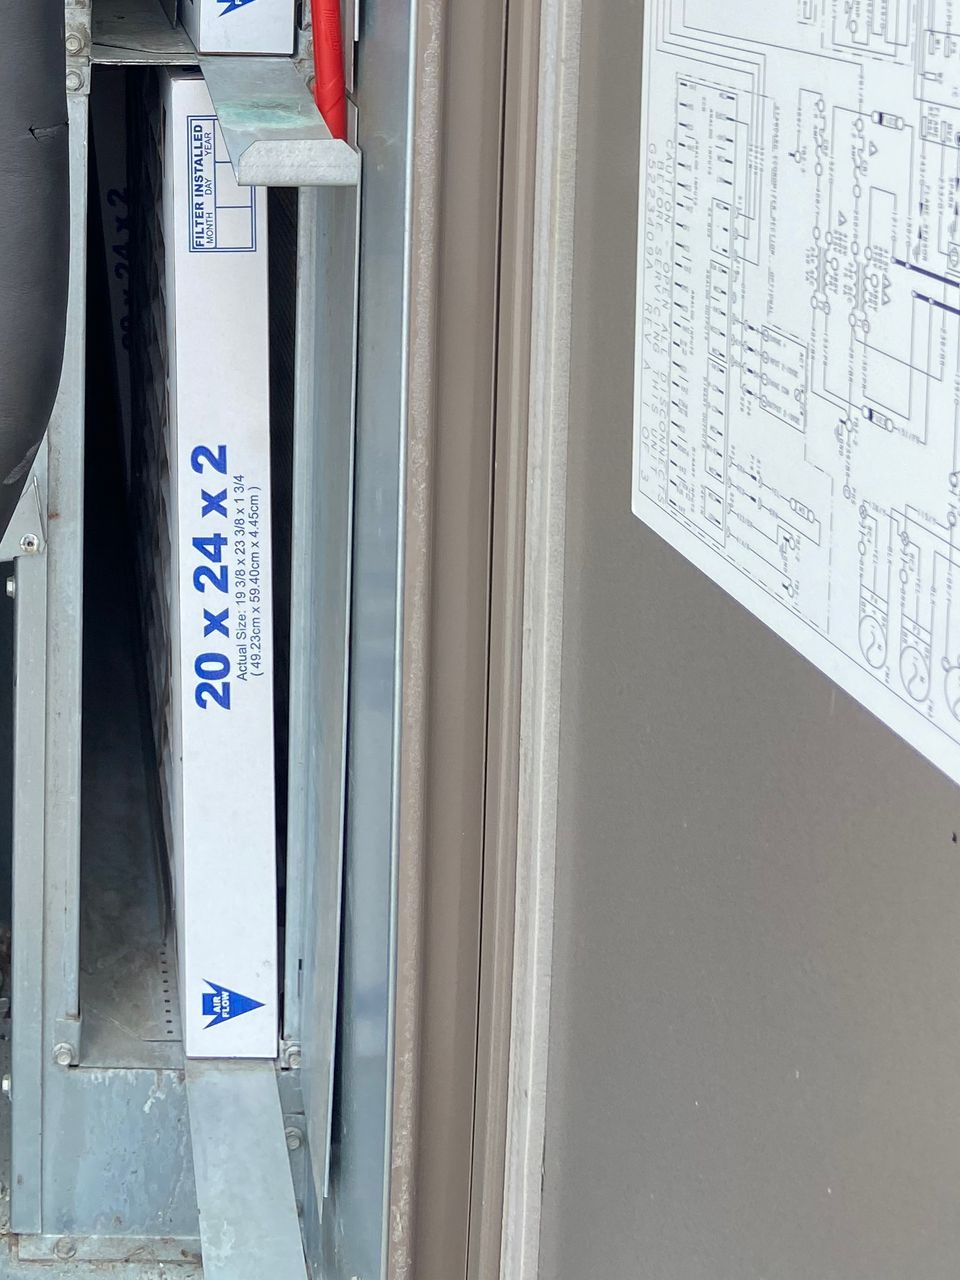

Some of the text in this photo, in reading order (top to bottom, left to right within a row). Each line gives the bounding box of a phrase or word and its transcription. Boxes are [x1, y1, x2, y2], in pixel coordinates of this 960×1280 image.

[193, 125, 204, 247] FILTER INSTALLED
[204, 132, 214, 244] MONTH DAY YEAR
[650, 160, 664, 475] BEFORE SERVICING THIS UNIT
[658, 139, 673, 505] CAUTION OPEN ALL DISCONNECTS
[233, 475, 246, 494] 3/4
[234, 518, 246, 537] 3/8
[248, 495, 260, 538] 4.45cm
[234, 540, 246, 555] 23
[237, 558, 246, 566] x
[190, 445, 231, 710] 20 x 24 x 2
[234, 569, 247, 588] 3/8
[248, 551, 261, 603] 59.40cm
[235, 591, 246, 605] 19
[252, 606, 261, 614] x
[235, 610, 248, 640] Size:
[250, 617, 262, 669] 49.23cm
[235, 644, 248, 681] Actual
[213, 996, 221, 1013] AIR
[222, 992, 230, 1018] FLOW
